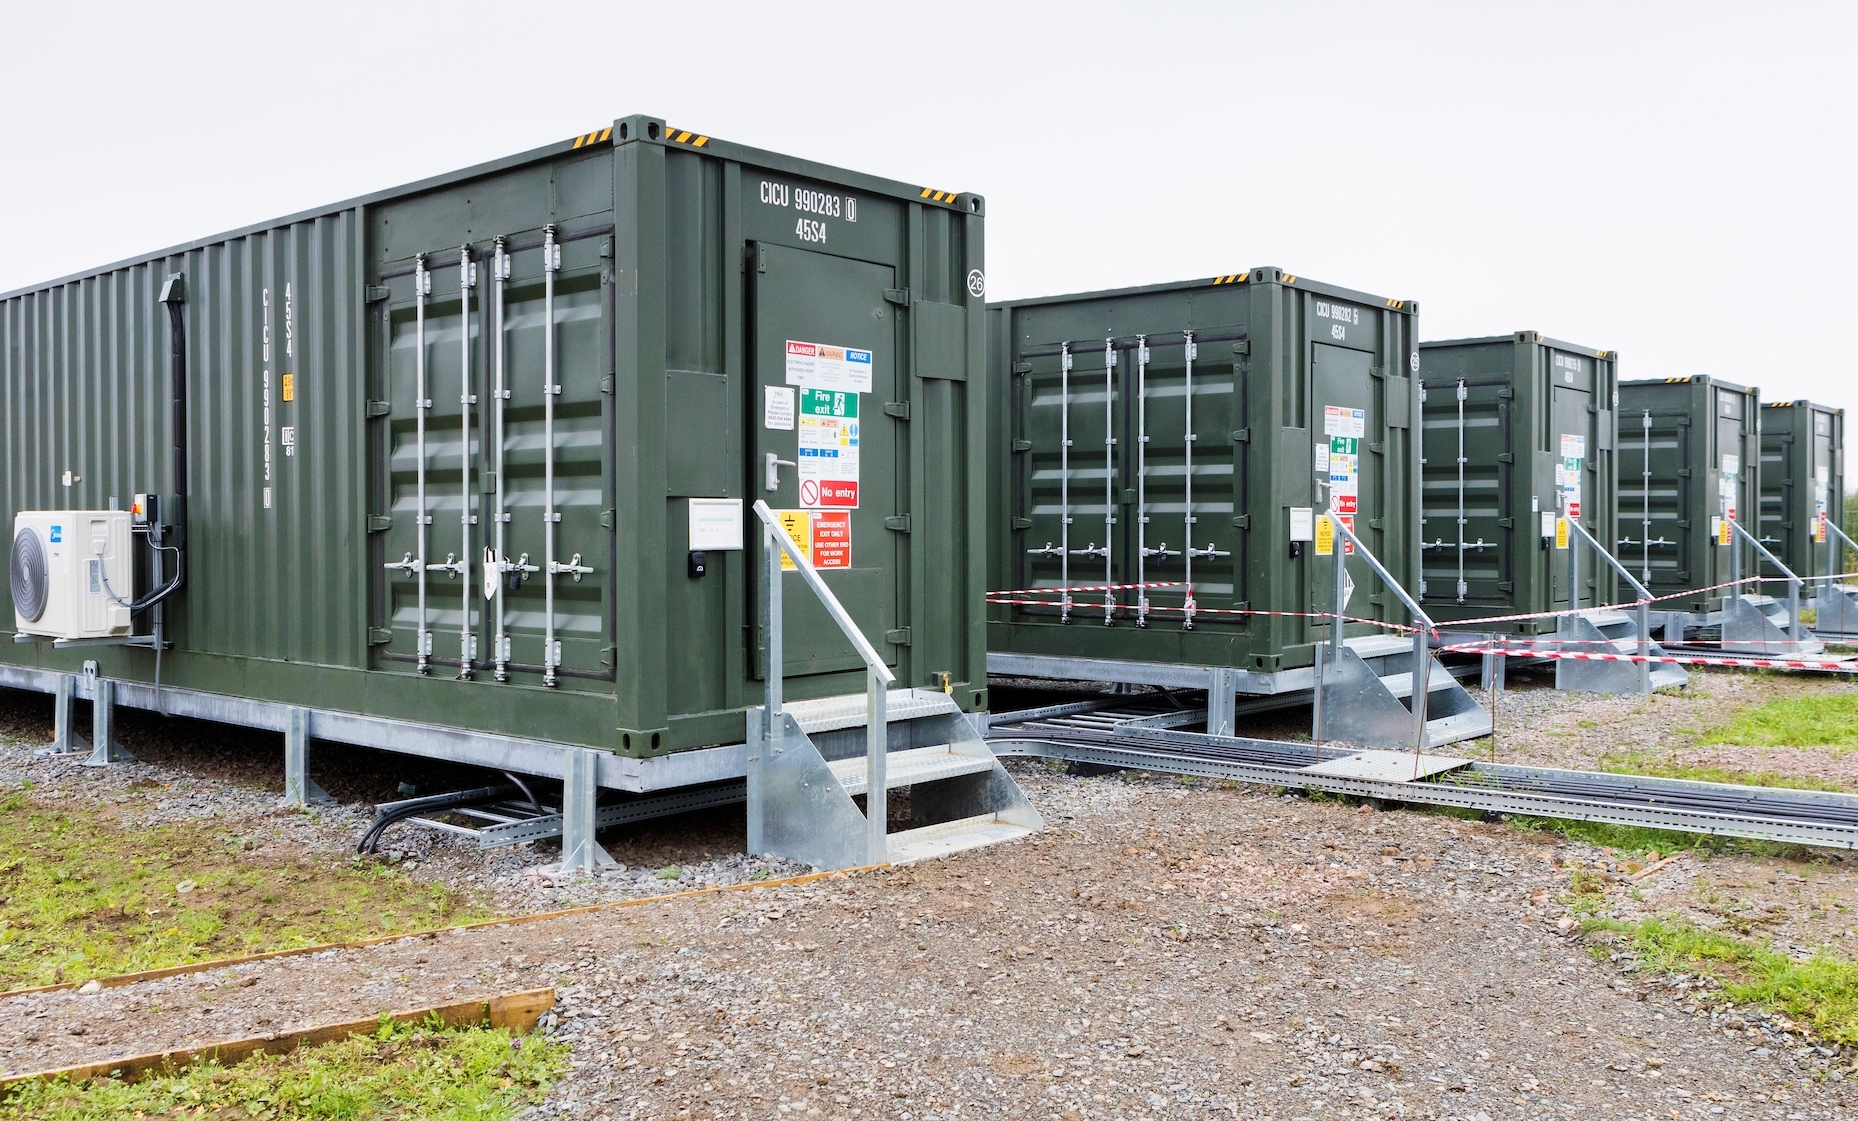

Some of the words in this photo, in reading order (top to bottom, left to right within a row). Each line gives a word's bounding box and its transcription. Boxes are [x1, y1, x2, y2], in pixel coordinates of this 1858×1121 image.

[760, 180, 788, 206] CICU
[795, 188, 840, 217] 990283
[795, 218, 826, 244] 45S4
[970, 275, 983, 291] 26
[795, 346, 815, 355] DANGER
[850, 352, 867, 360] NOTICE
[815, 390, 830, 401] Fire
[815, 405, 830, 415] exit
[821, 487, 832, 497] No
[835, 488, 855, 499] entry
